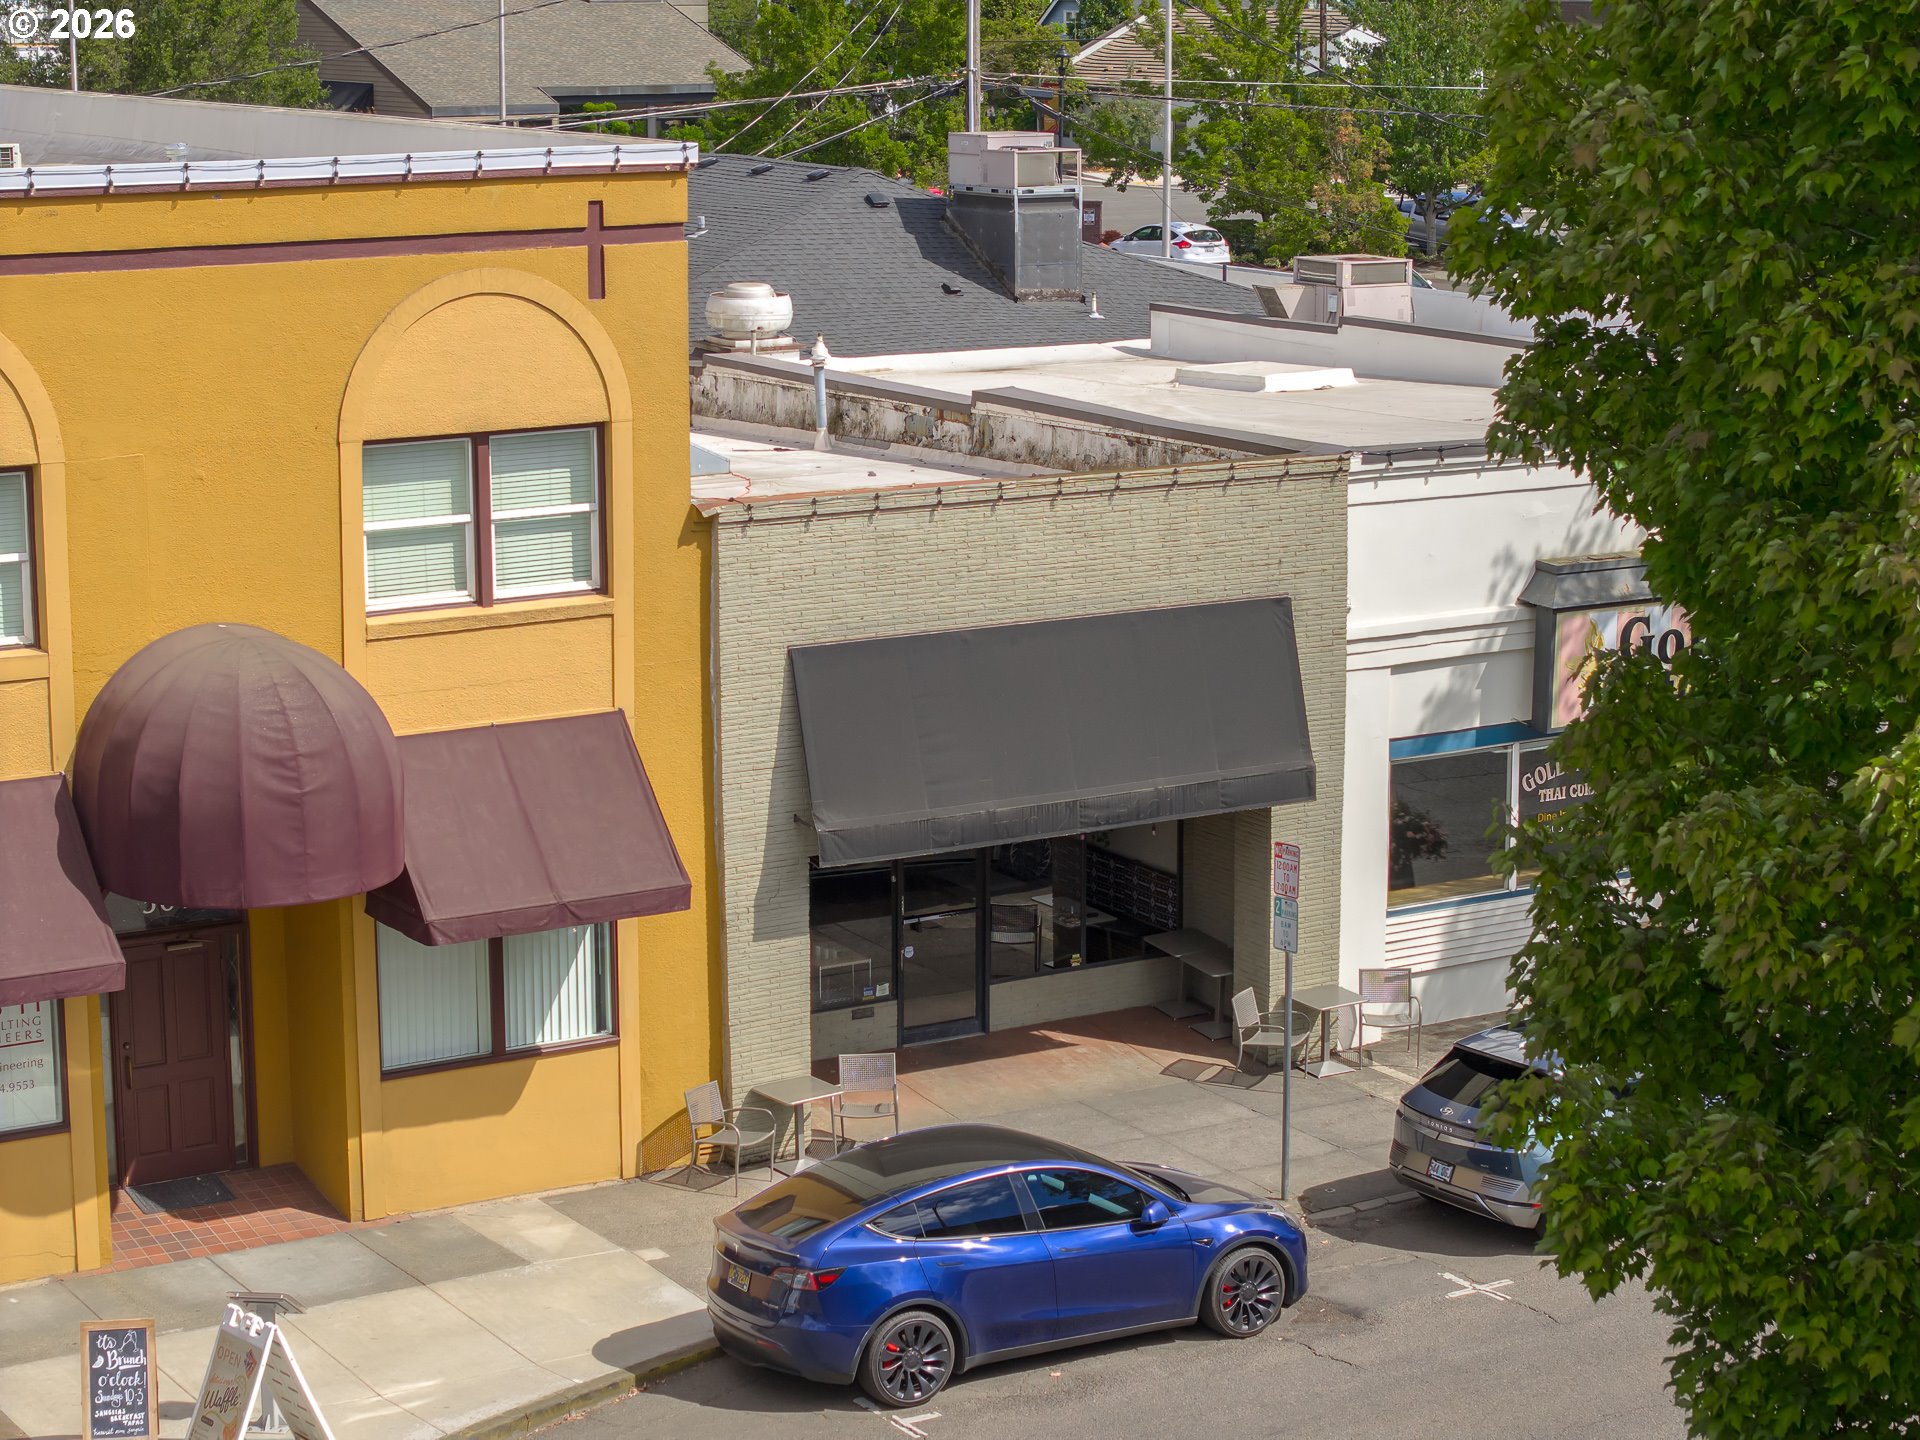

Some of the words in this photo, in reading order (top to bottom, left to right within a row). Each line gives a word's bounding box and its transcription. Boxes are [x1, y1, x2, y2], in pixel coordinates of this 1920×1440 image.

[1620, 614, 1684, 664] Go
[1539, 786, 1566, 802] THAI
[1537, 813, 1557, 823] Dine
[1283, 873, 1290, 883] TO
[1275, 900, 1281, 914] 2
[1, 1016, 41, 1030] LTING
[0, 1029, 42, 1043] EERS
[106, 1349, 147, 1370] Brunch
[216, 1346, 241, 1368] OPEN
[110, 1412, 146, 1422] BREAKFAST
